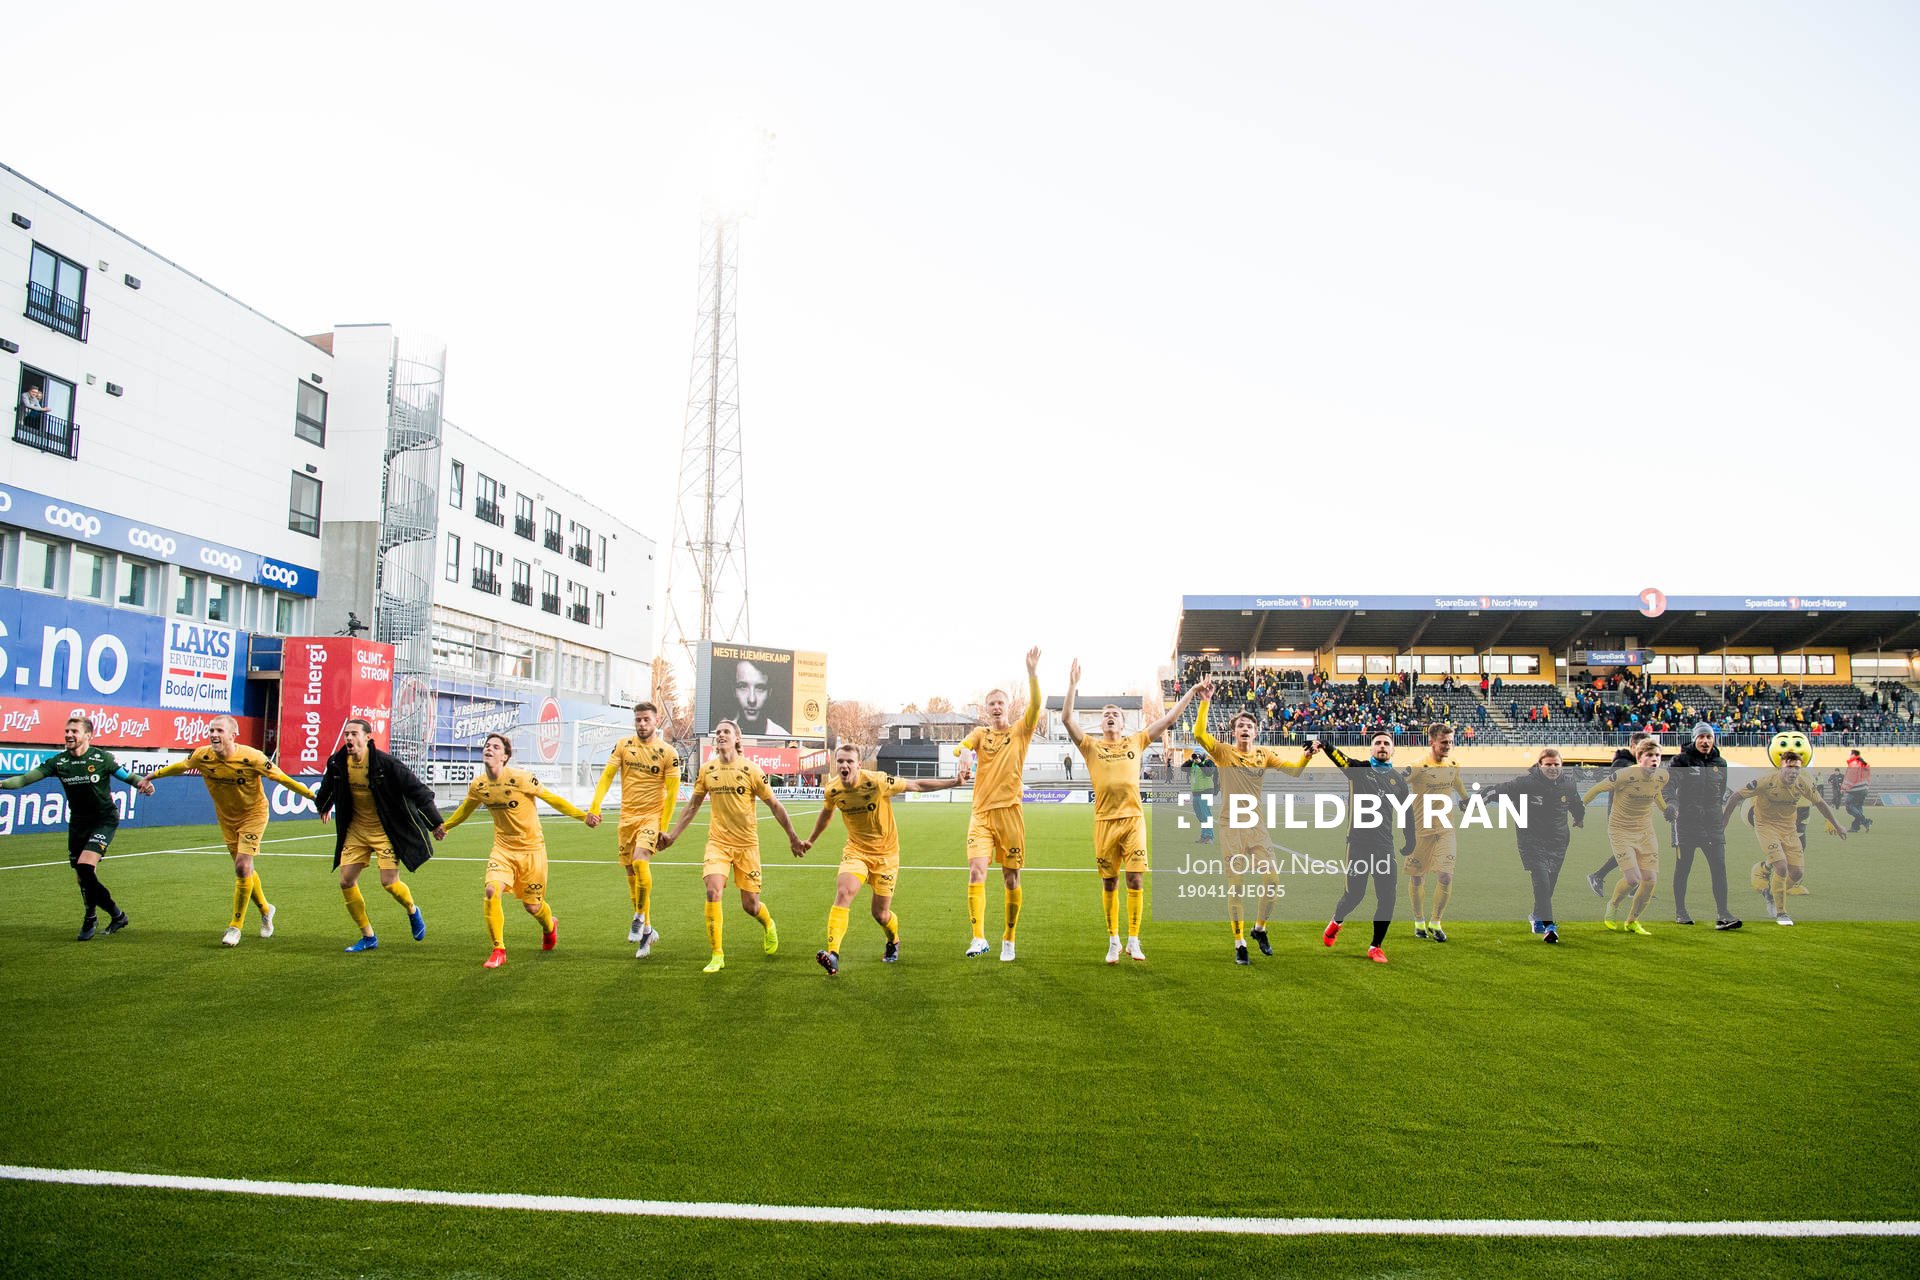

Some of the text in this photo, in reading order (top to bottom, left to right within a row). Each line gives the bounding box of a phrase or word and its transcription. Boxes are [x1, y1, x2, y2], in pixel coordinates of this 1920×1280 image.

[45, 505, 101, 538] coop
[128, 527, 176, 558] coop
[200, 547, 242, 575] coop
[262, 563, 299, 588] coop
[1256, 598, 1298, 608] SpareBank
[1312, 598, 1359, 608] Nord-Norge
[1435, 598, 1477, 608] SpareBank
[1491, 598, 1538, 608] Nord-Norge
[1745, 599, 1787, 609] SpareBank
[1801, 599, 1847, 609] Nord-Norge
[170, 623, 230, 658] LAKS
[0, 618, 128, 694] .no
[169, 653, 228, 671] ER VIKTIG FOR
[357, 650, 386, 665] GLIMT-
[713, 647, 739, 659] NESTE
[740, 650, 791, 664] HJEMMEKAMP
[1592, 653, 1625, 661] SpareBank
[361, 667, 389, 682] STRØM
[165, 680, 228, 701] Bodø/Glimt
[300, 644, 328, 762] Bodø Energi
[351, 705, 363, 717] For
[363, 706, 376, 721] deg
[70, 708, 119, 738] ppes
[174, 715, 212, 745] Peppe
[1023, 791, 1065, 800] obbfrukt.no
[0, 785, 138, 835] gnan!
